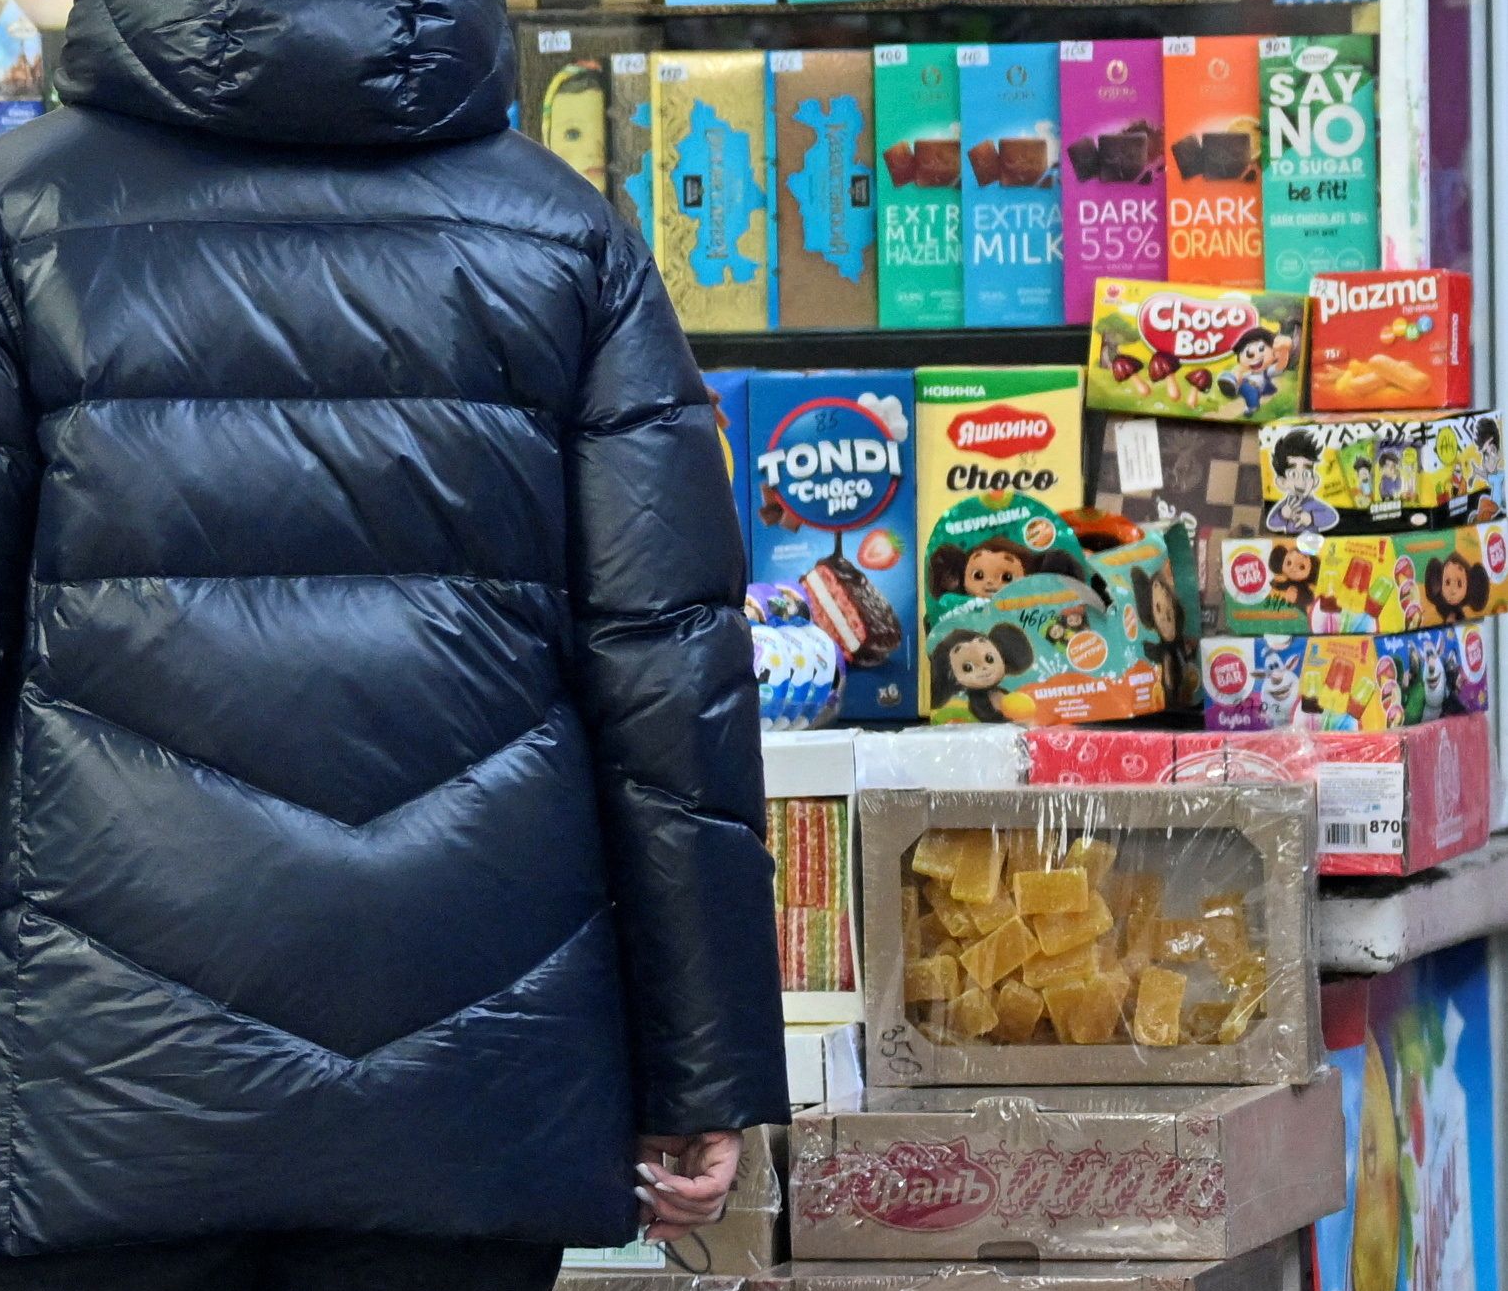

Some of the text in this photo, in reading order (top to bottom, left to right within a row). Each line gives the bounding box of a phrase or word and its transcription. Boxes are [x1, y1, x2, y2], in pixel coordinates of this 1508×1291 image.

[1268, 74, 1363, 106] SAY
[1268, 104, 1366, 159] NO
[1271, 158, 1364, 175] TO SUGAR
[1287, 179, 1348, 202] be fit!
[886, 205, 960, 223] EXTR
[974, 200, 1062, 232] EXTRA
[1079, 200, 1159, 224] DARK
[1170, 198, 1256, 227] DARK
[886, 226, 959, 242] MILK
[1079, 227, 1161, 261] 55%
[1170, 229, 1262, 259] ORANG
[886, 245, 962, 265] HAZELN
[973, 235, 1063, 265] MILK
[1149, 298, 1247, 332] Choco
[1174, 331, 1224, 359] Boy
[923, 384, 986, 399] НОВИНКА
[957, 418, 1048, 446] Яшкино
[757, 437, 902, 489] TONDI
[787, 478, 873, 503] Choco
[946, 464, 1059, 491] Choco
[944, 506, 1032, 537] ЧЕБУРАШКА
[1236, 570, 1264, 588] BAR
[1216, 670, 1243, 687] BAR
[1369, 820, 1401, 834] 870
